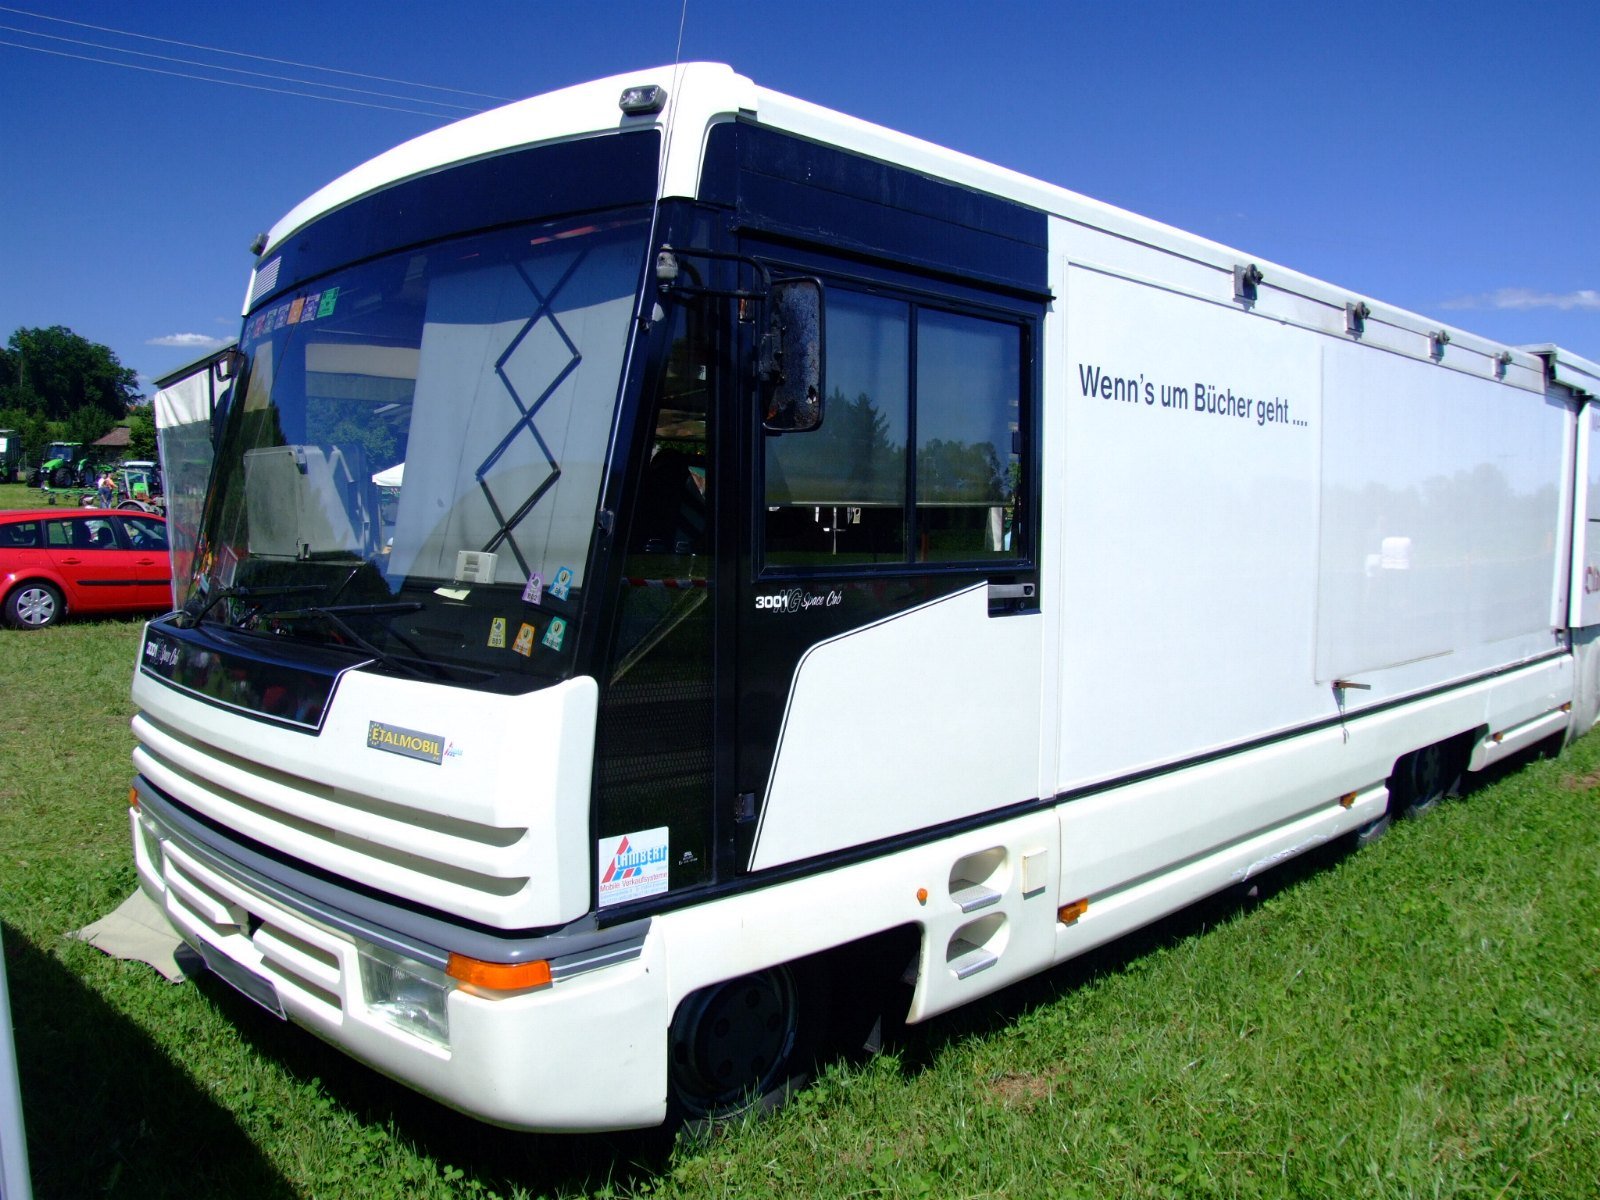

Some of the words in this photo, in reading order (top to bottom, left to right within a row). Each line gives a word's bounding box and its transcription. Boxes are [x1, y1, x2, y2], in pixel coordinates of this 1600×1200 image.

[1078, 363, 1155, 406] Wenn's
[1160, 384, 1188, 410] um
[1194, 382, 1253, 419] Bücher
[1256, 397, 1289, 426] geht
[755, 595, 788, 609] 3001
[801, 592, 825, 610] Space
[826, 590, 842, 607] Cab
